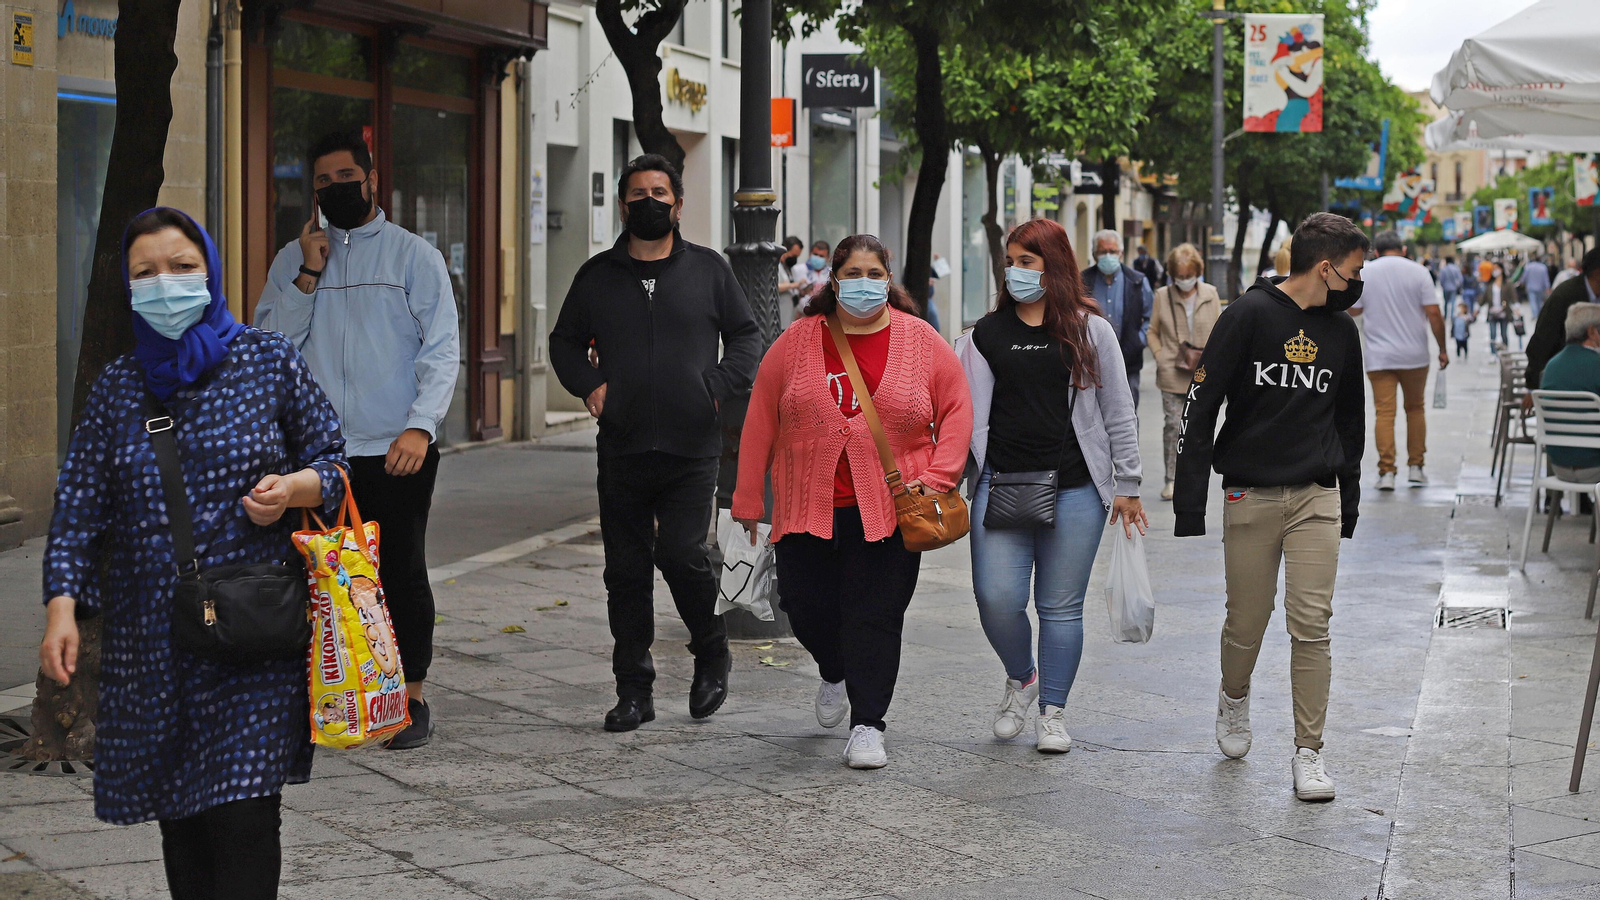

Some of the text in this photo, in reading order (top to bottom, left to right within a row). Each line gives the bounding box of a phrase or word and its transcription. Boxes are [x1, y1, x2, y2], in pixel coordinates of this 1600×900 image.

[78, 15, 118, 38] movis
[1250, 24, 1267, 42] 25
[771, 133, 788, 146] nge
[1253, 361, 1333, 393] KING
[1176, 384, 1200, 454] KING
[345, 691, 357, 733] CHURRUCA
